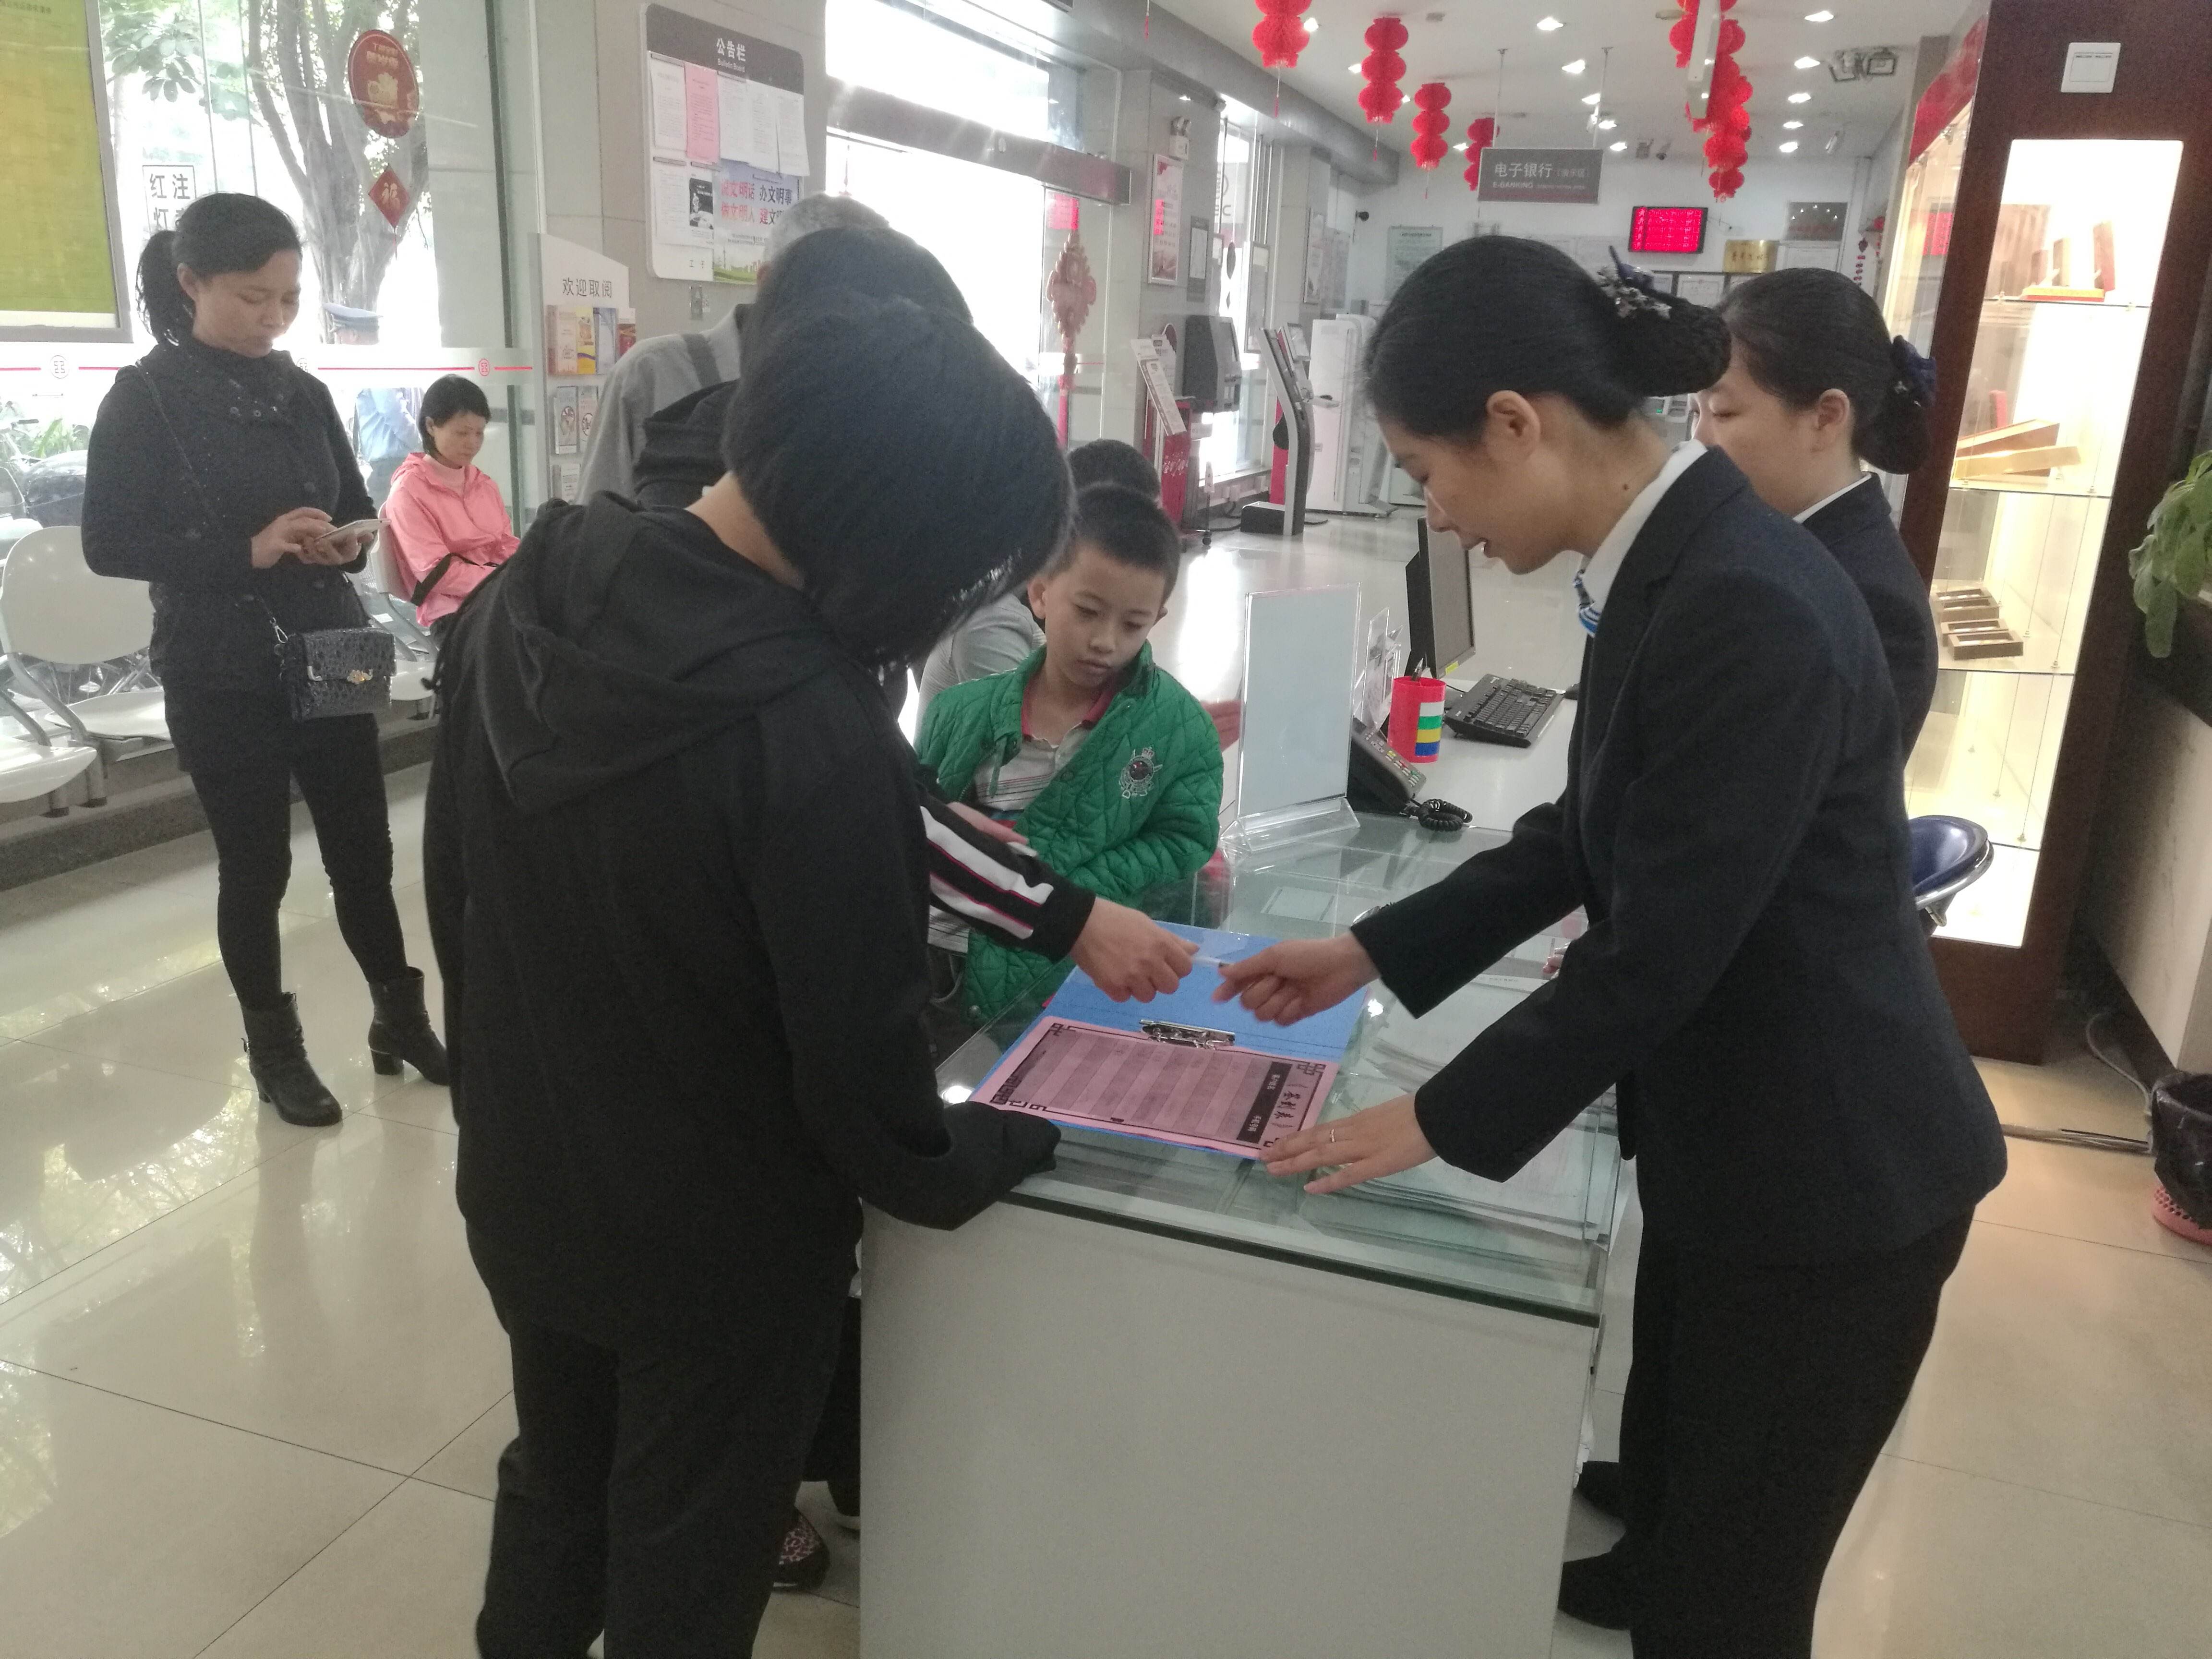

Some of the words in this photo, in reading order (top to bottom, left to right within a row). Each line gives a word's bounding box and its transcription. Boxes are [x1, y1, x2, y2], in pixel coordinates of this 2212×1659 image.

[716, 38, 746, 62] 公告栏
[1494, 162, 1552, 178] 电子银行
[759, 184, 792, 205] 办文明事
[562, 277, 612, 298] 欢迎取阅
